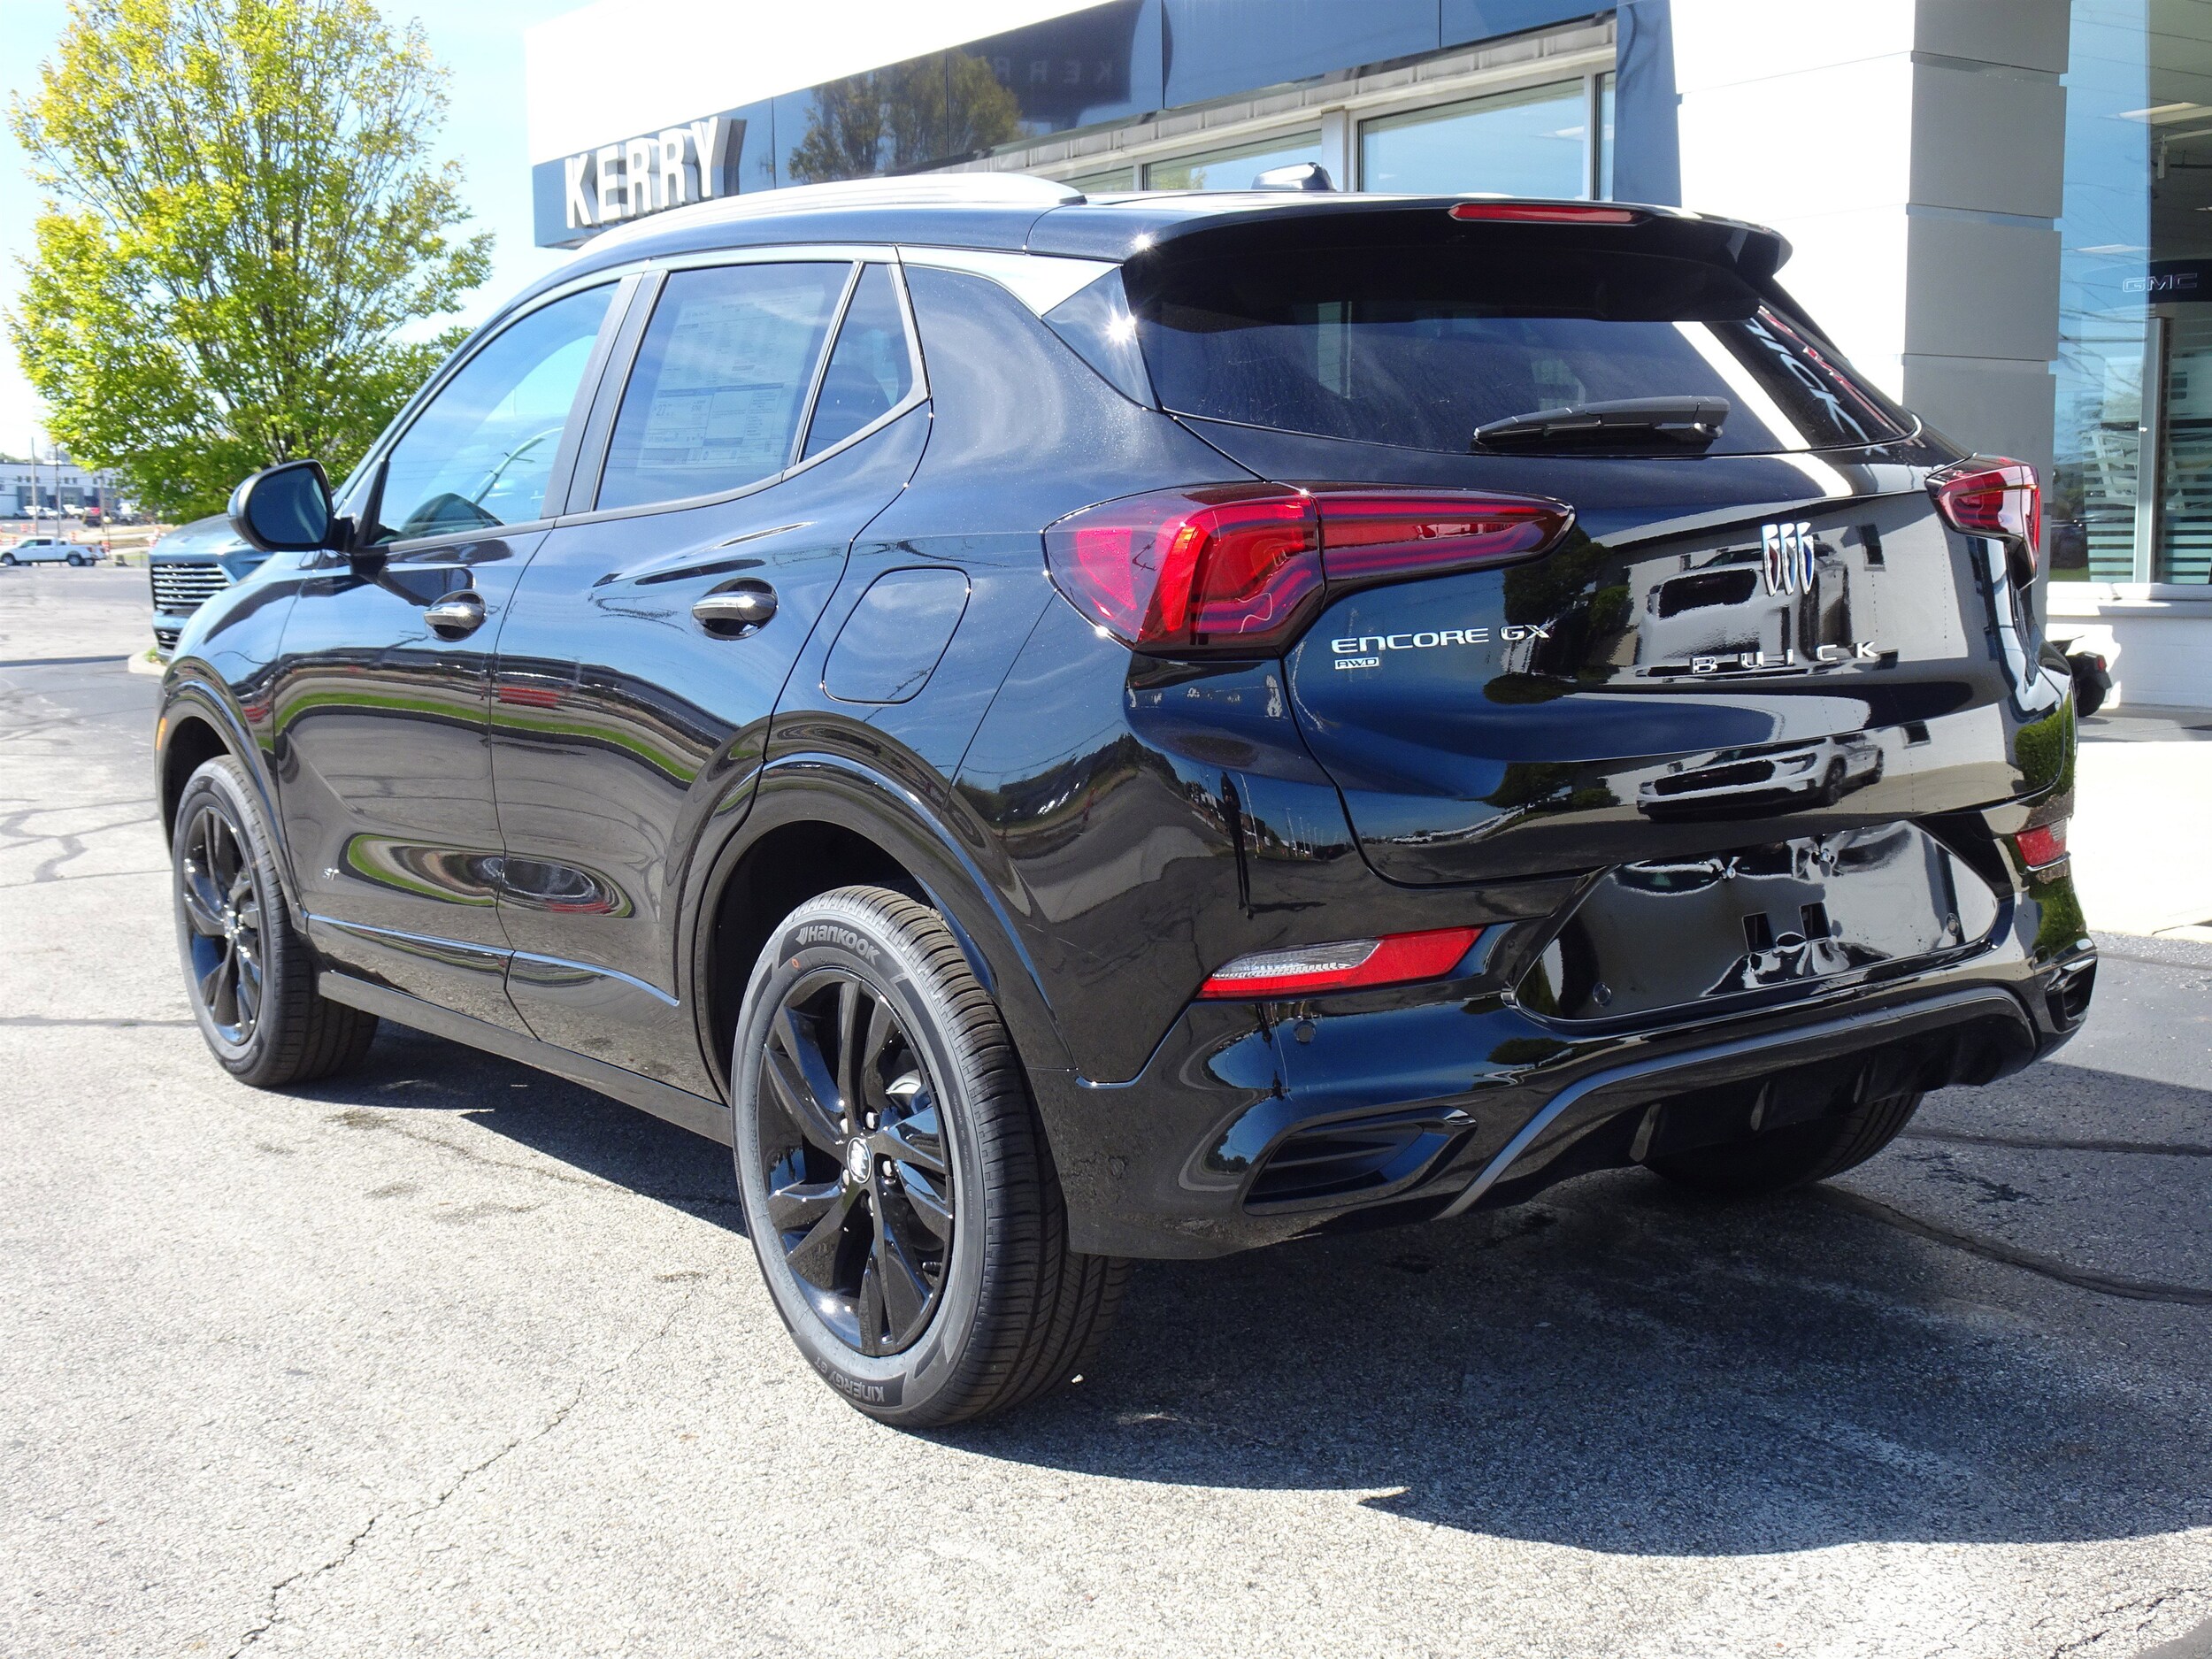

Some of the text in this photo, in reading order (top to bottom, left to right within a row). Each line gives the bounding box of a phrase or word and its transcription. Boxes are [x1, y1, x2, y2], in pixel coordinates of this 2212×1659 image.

[565, 116, 722, 230] KERRY
[2122, 273, 2198, 293] GMC
[1331, 623, 1550, 654] ENCORE GX
[1335, 657, 1379, 670] AWD
[1689, 641, 1878, 675] BUICK
[813, 1356, 886, 1402] KINERGY GT
